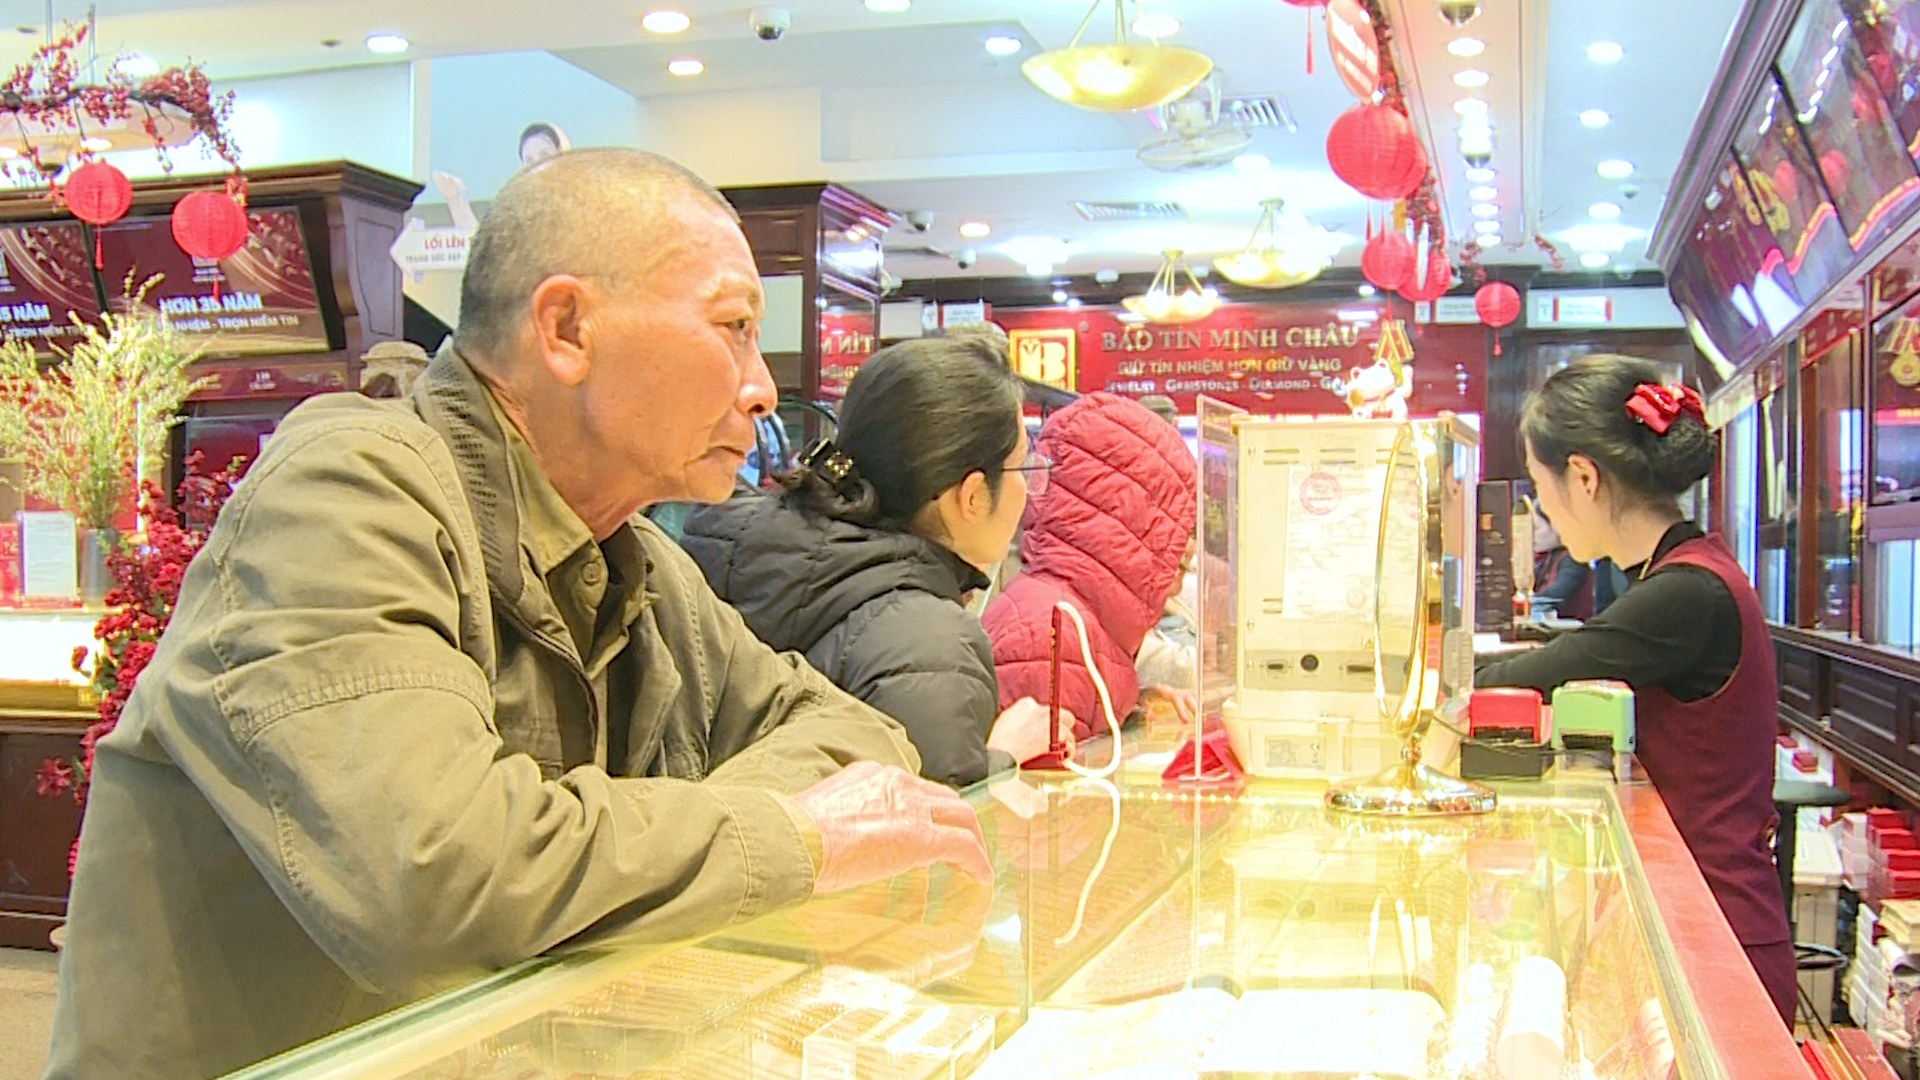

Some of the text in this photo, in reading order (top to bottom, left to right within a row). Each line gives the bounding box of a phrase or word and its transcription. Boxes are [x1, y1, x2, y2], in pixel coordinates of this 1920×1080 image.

[446, 235, 465, 248] LÊN
[0, 302, 51, 322] 5 NĂM
[159, 291, 262, 314] HƠN 35 NĂM
[217, 316, 248, 330] TRỌN
[279, 314, 299, 326] TIN
[1159, 325, 1200, 349] TÍN
[1209, 328, 1278, 349] MINH
[1285, 321, 1359, 348] CHÂU
[1149, 356, 1173, 373] TÍN
[1176, 356, 1224, 375] NHIỆM
[1228, 357, 1261, 373] HƠN
[1264, 354, 1293, 372] GIỮ
[1298, 354, 1341, 372] VÀNG
